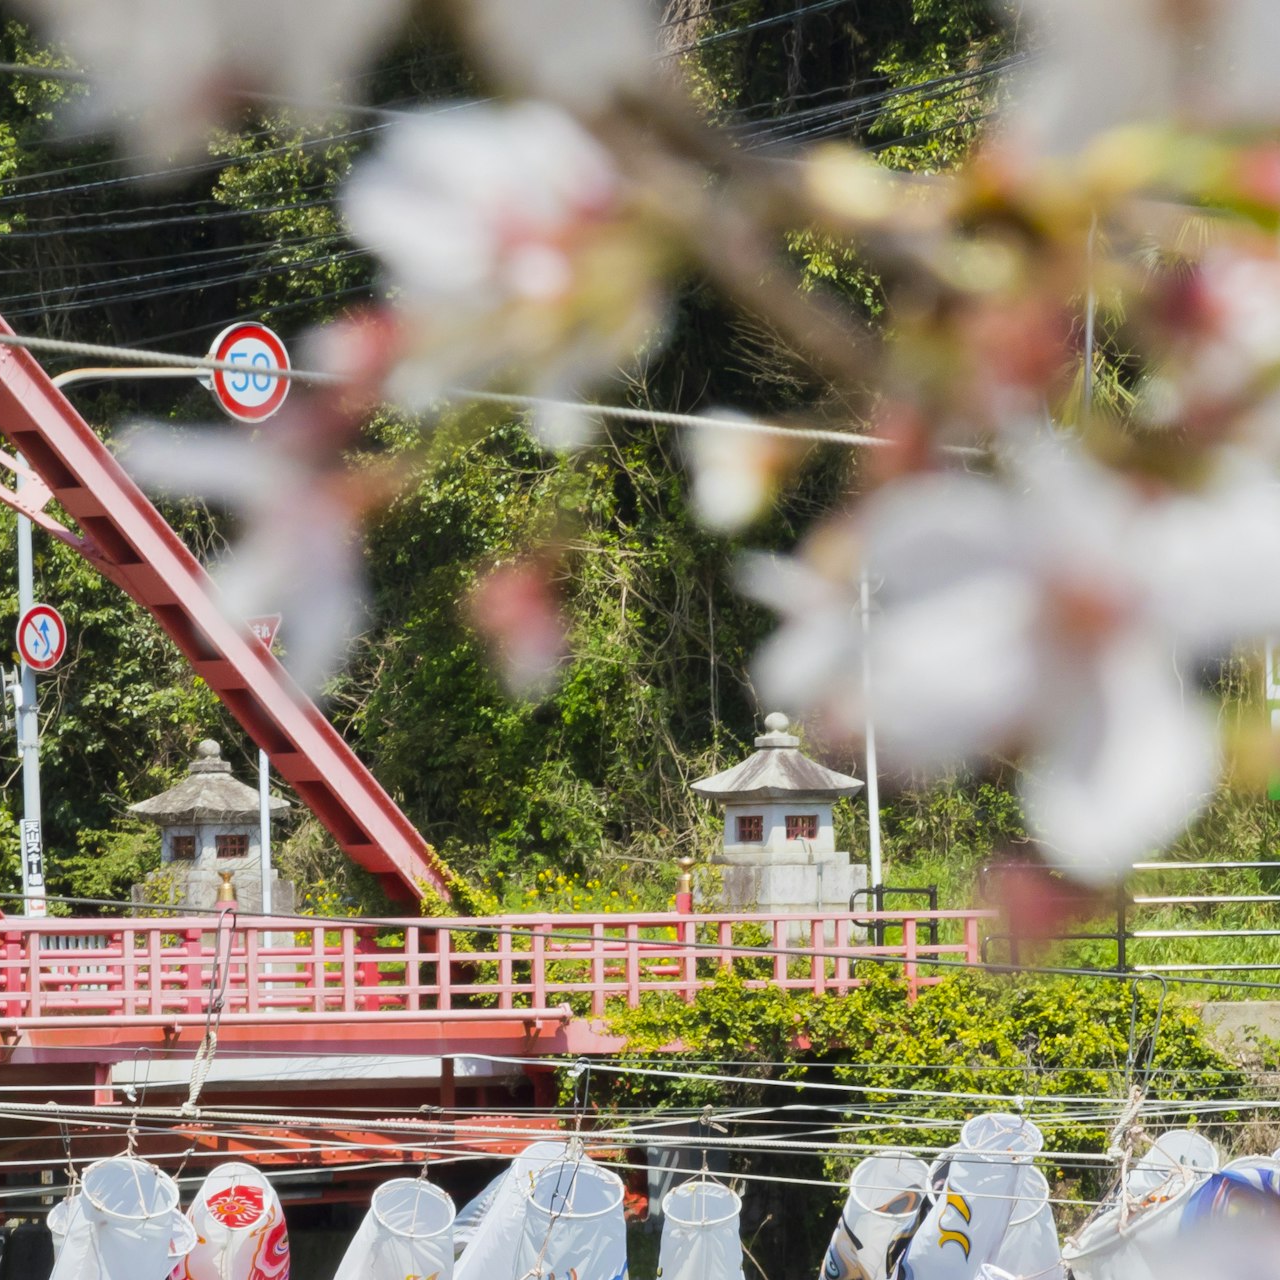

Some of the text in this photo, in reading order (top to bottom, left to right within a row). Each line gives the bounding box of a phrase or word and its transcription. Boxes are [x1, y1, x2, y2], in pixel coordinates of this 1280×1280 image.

[230, 352, 271, 392] 50
[24, 821, 42, 886] 天山スキー場
